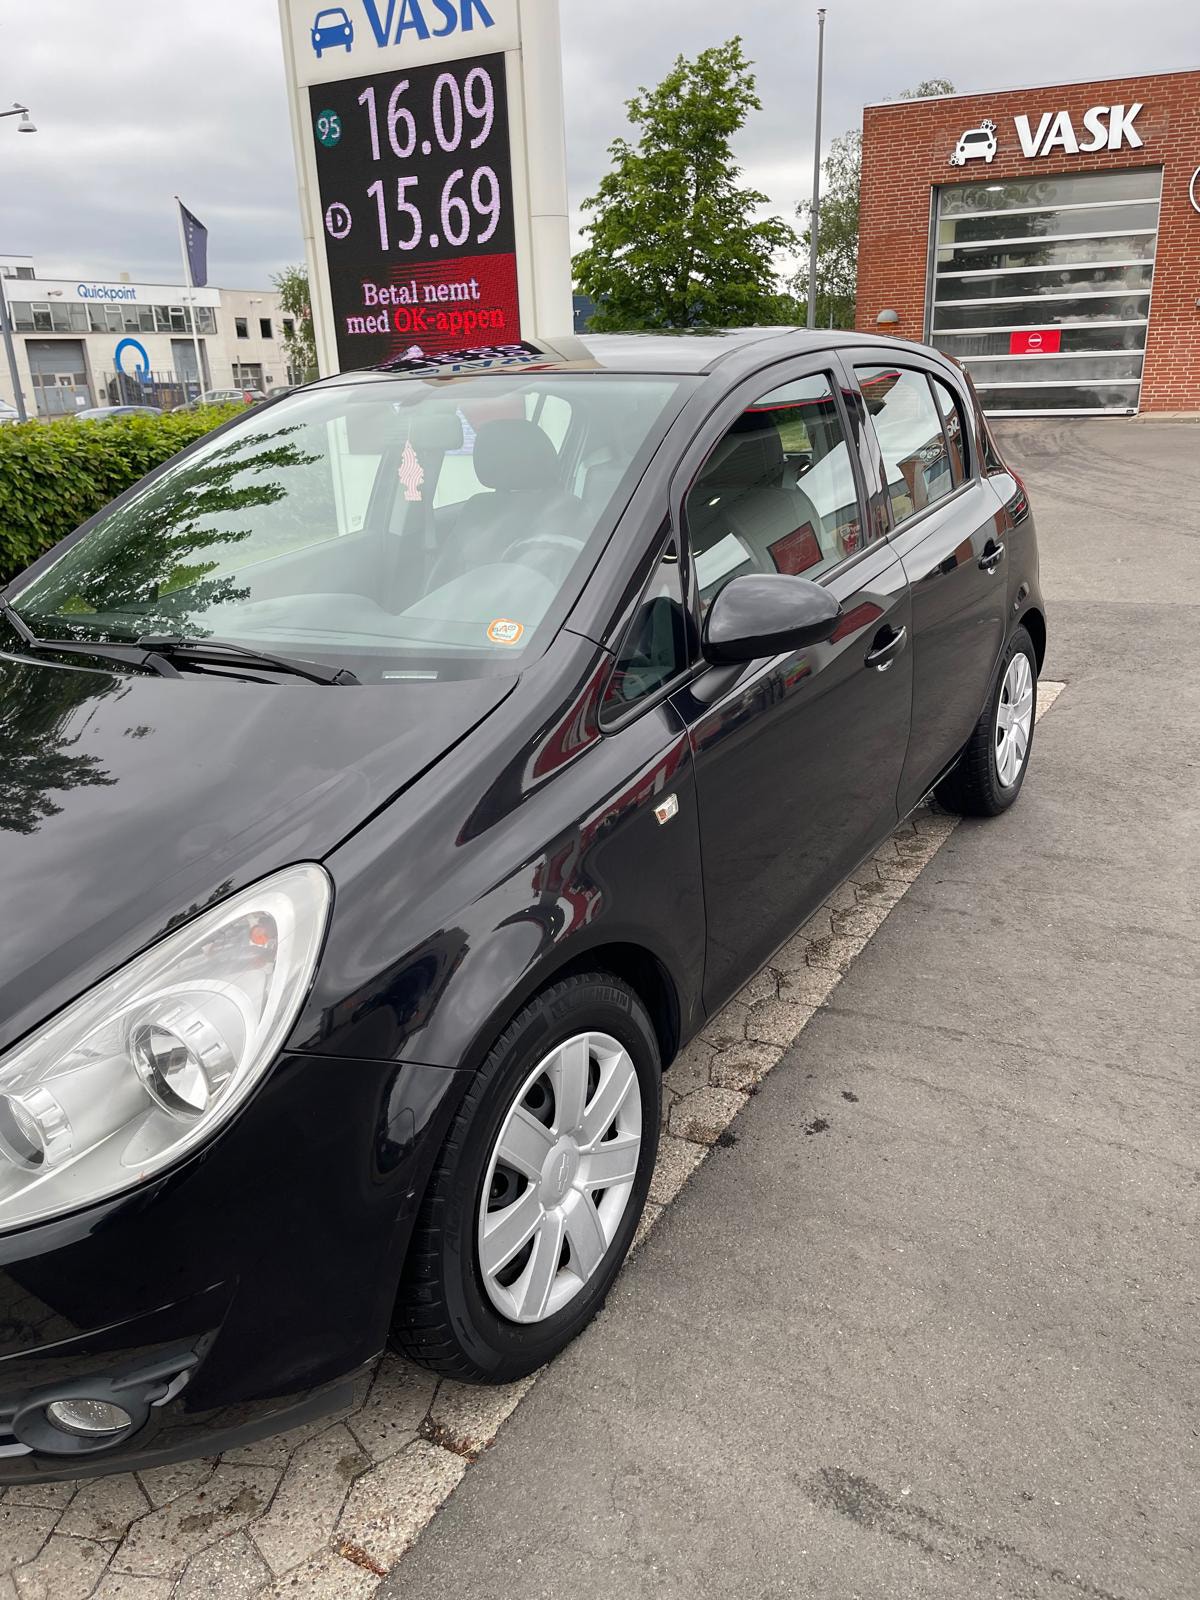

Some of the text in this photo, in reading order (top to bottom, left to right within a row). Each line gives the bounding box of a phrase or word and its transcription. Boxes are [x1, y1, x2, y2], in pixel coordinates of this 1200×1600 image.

[363, 0, 495, 48] VASK
[317, 67, 495, 161] 95 16.09
[1014, 102, 1144, 158] VASK
[366, 165, 501, 251] 15.69
[77, 284, 137, 302] Quickpoint
[362, 277, 481, 306] Betal nemt
[346, 307, 506, 336] med OK-appen
